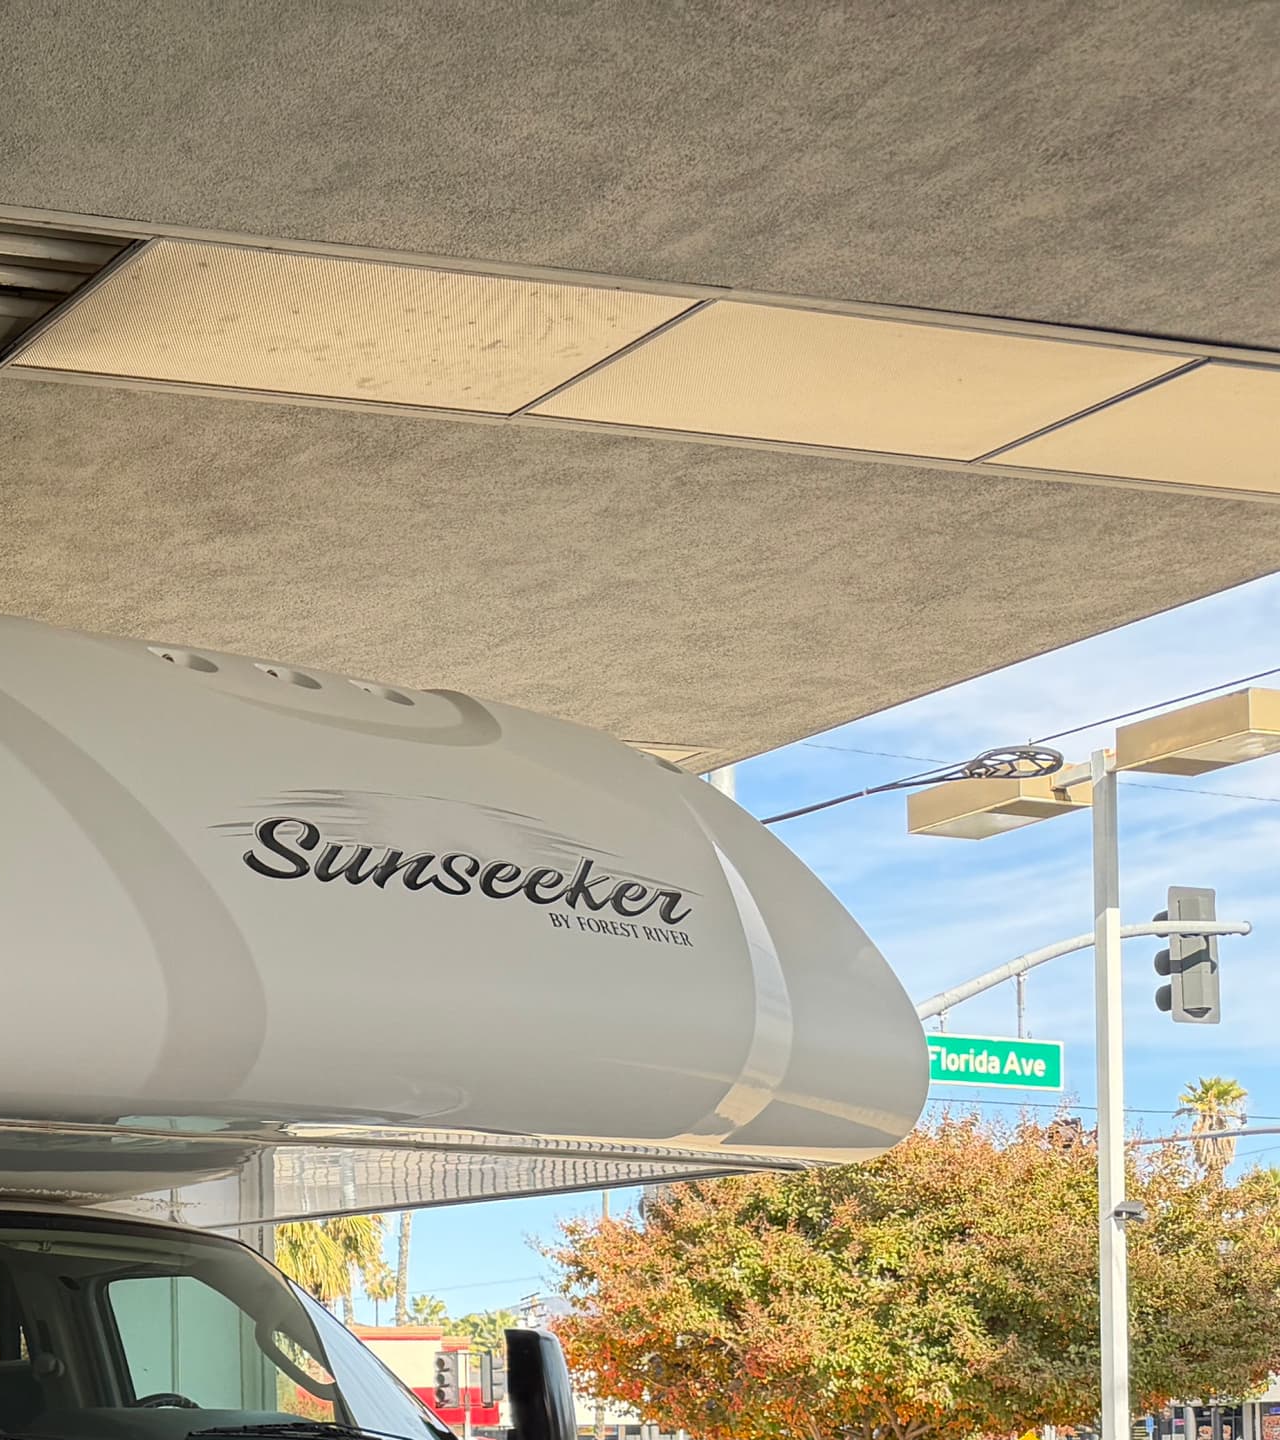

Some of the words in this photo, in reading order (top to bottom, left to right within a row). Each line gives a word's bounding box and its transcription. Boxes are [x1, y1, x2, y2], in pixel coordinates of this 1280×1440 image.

[242, 817, 693, 925] Sunseeker
[549, 911, 572, 929] BY
[577, 916, 640, 940] FOREST
[643, 925, 695, 947] RIVER
[1003, 1050, 1046, 1078] Ave
